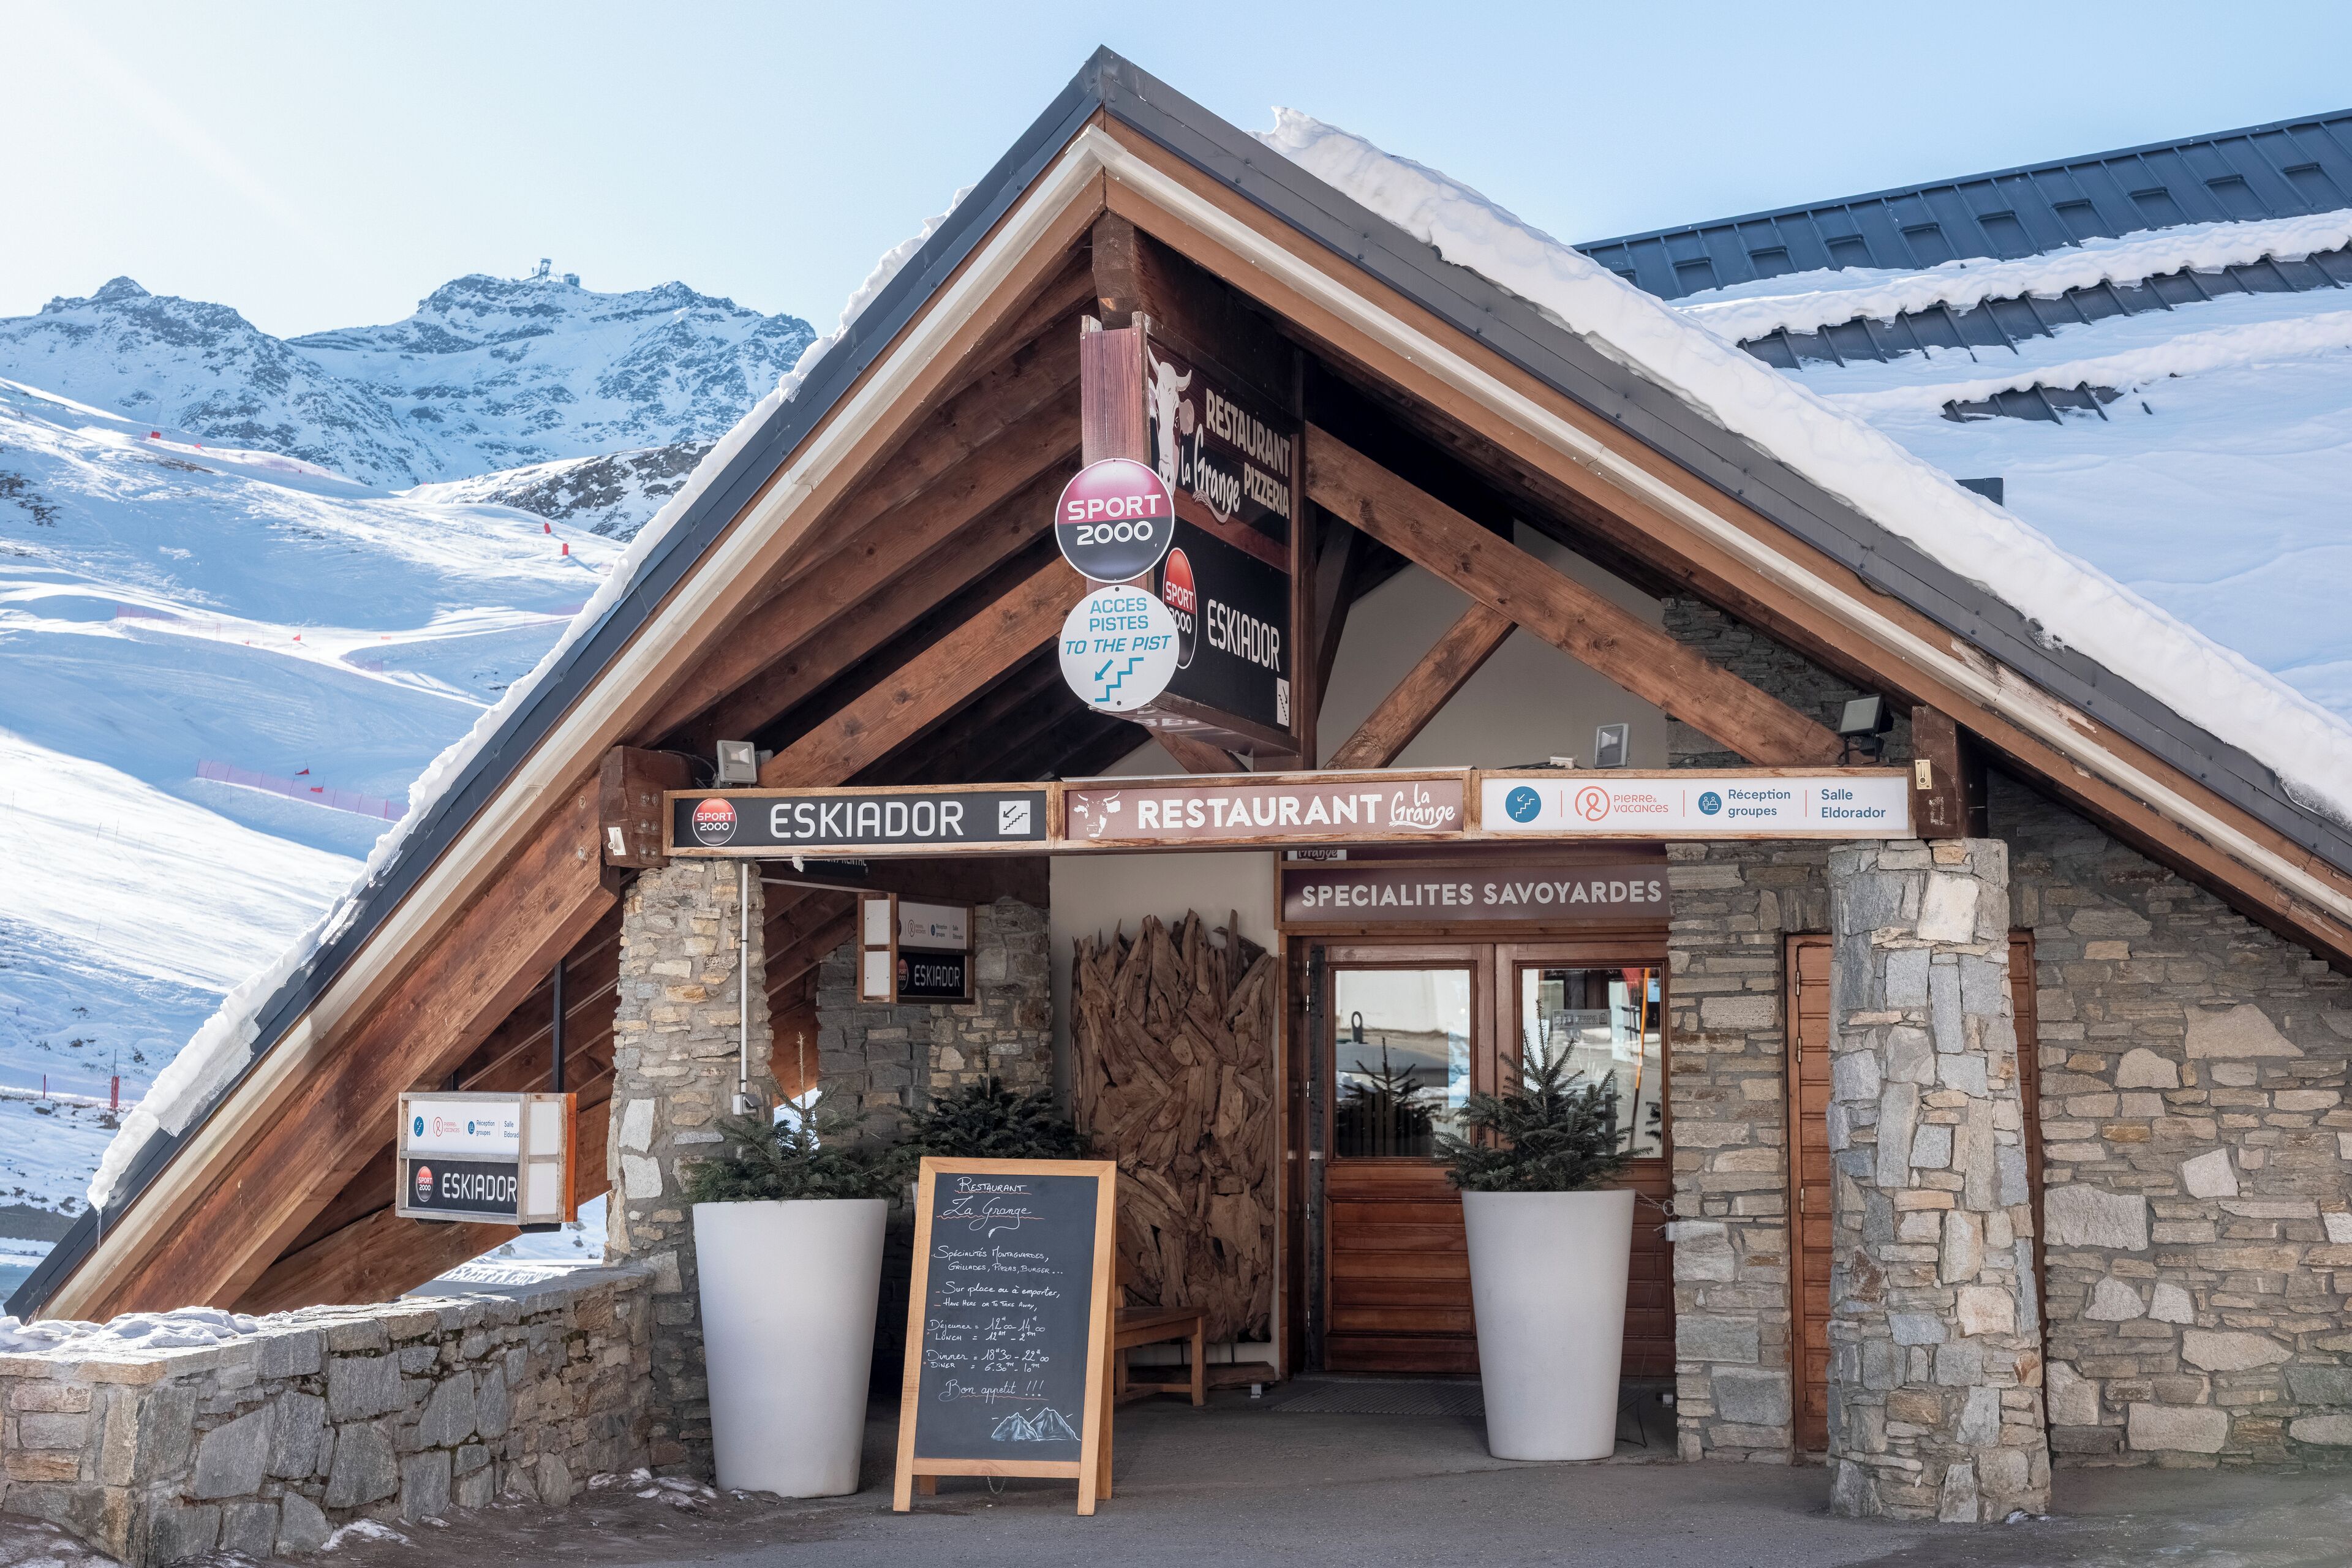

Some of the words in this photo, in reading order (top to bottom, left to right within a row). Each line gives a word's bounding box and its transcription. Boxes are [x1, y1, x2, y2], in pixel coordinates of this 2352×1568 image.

[1206, 388, 1290, 478] RESTAURANT
[1181, 445, 1191, 486] la
[1193, 423, 1240, 521] Grange
[1244, 462, 1289, 519] PIZZERIA
[1068, 494, 1161, 521] SPORT
[1077, 521, 1153, 545] 2000
[1090, 597, 1147, 614] ACCES
[1166, 581, 1194, 611] SPORT
[1089, 615, 1148, 631] PISTES
[1207, 598, 1280, 672] ESKIADOR
[1065, 640, 1087, 655] TO
[1093, 638, 1128, 653] THE
[1131, 635, 1172, 651] PIST
[1414, 783, 1430, 807] la
[1728, 788, 1790, 802] Réception
[1821, 788, 1853, 801] Salle
[697, 812, 733, 821] SPORT
[770, 801, 964, 839] ESKIADOR
[1137, 794, 1382, 829] RESTAURANT
[1389, 791, 1455, 829] Grange
[1728, 807, 1777, 818] groupes
[1821, 806, 1886, 818] Eldorador
[700, 822, 729, 831] 2000
[1302, 884, 1473, 907] SPECIALITES
[1483, 881, 1662, 905] SAVOYARDES
[914, 965, 960, 987] ESKIADOR
[442, 1173, 517, 1202] ESKIADOR
[943, 1195, 973, 1215] La
[969, 1196, 1032, 1232] Grange
[942, 1281, 964, 1294] Sur
[968, 1283, 996, 1297] place
[1012, 1285, 1019, 1294] à
[1022, 1286, 1060, 1298] emporter,
[927, 1319, 972, 1337] Déjeuner
[926, 1349, 968, 1362] Dinner
[938, 1379, 976, 1402] Bon
[981, 1381, 1017, 1404] appetit
